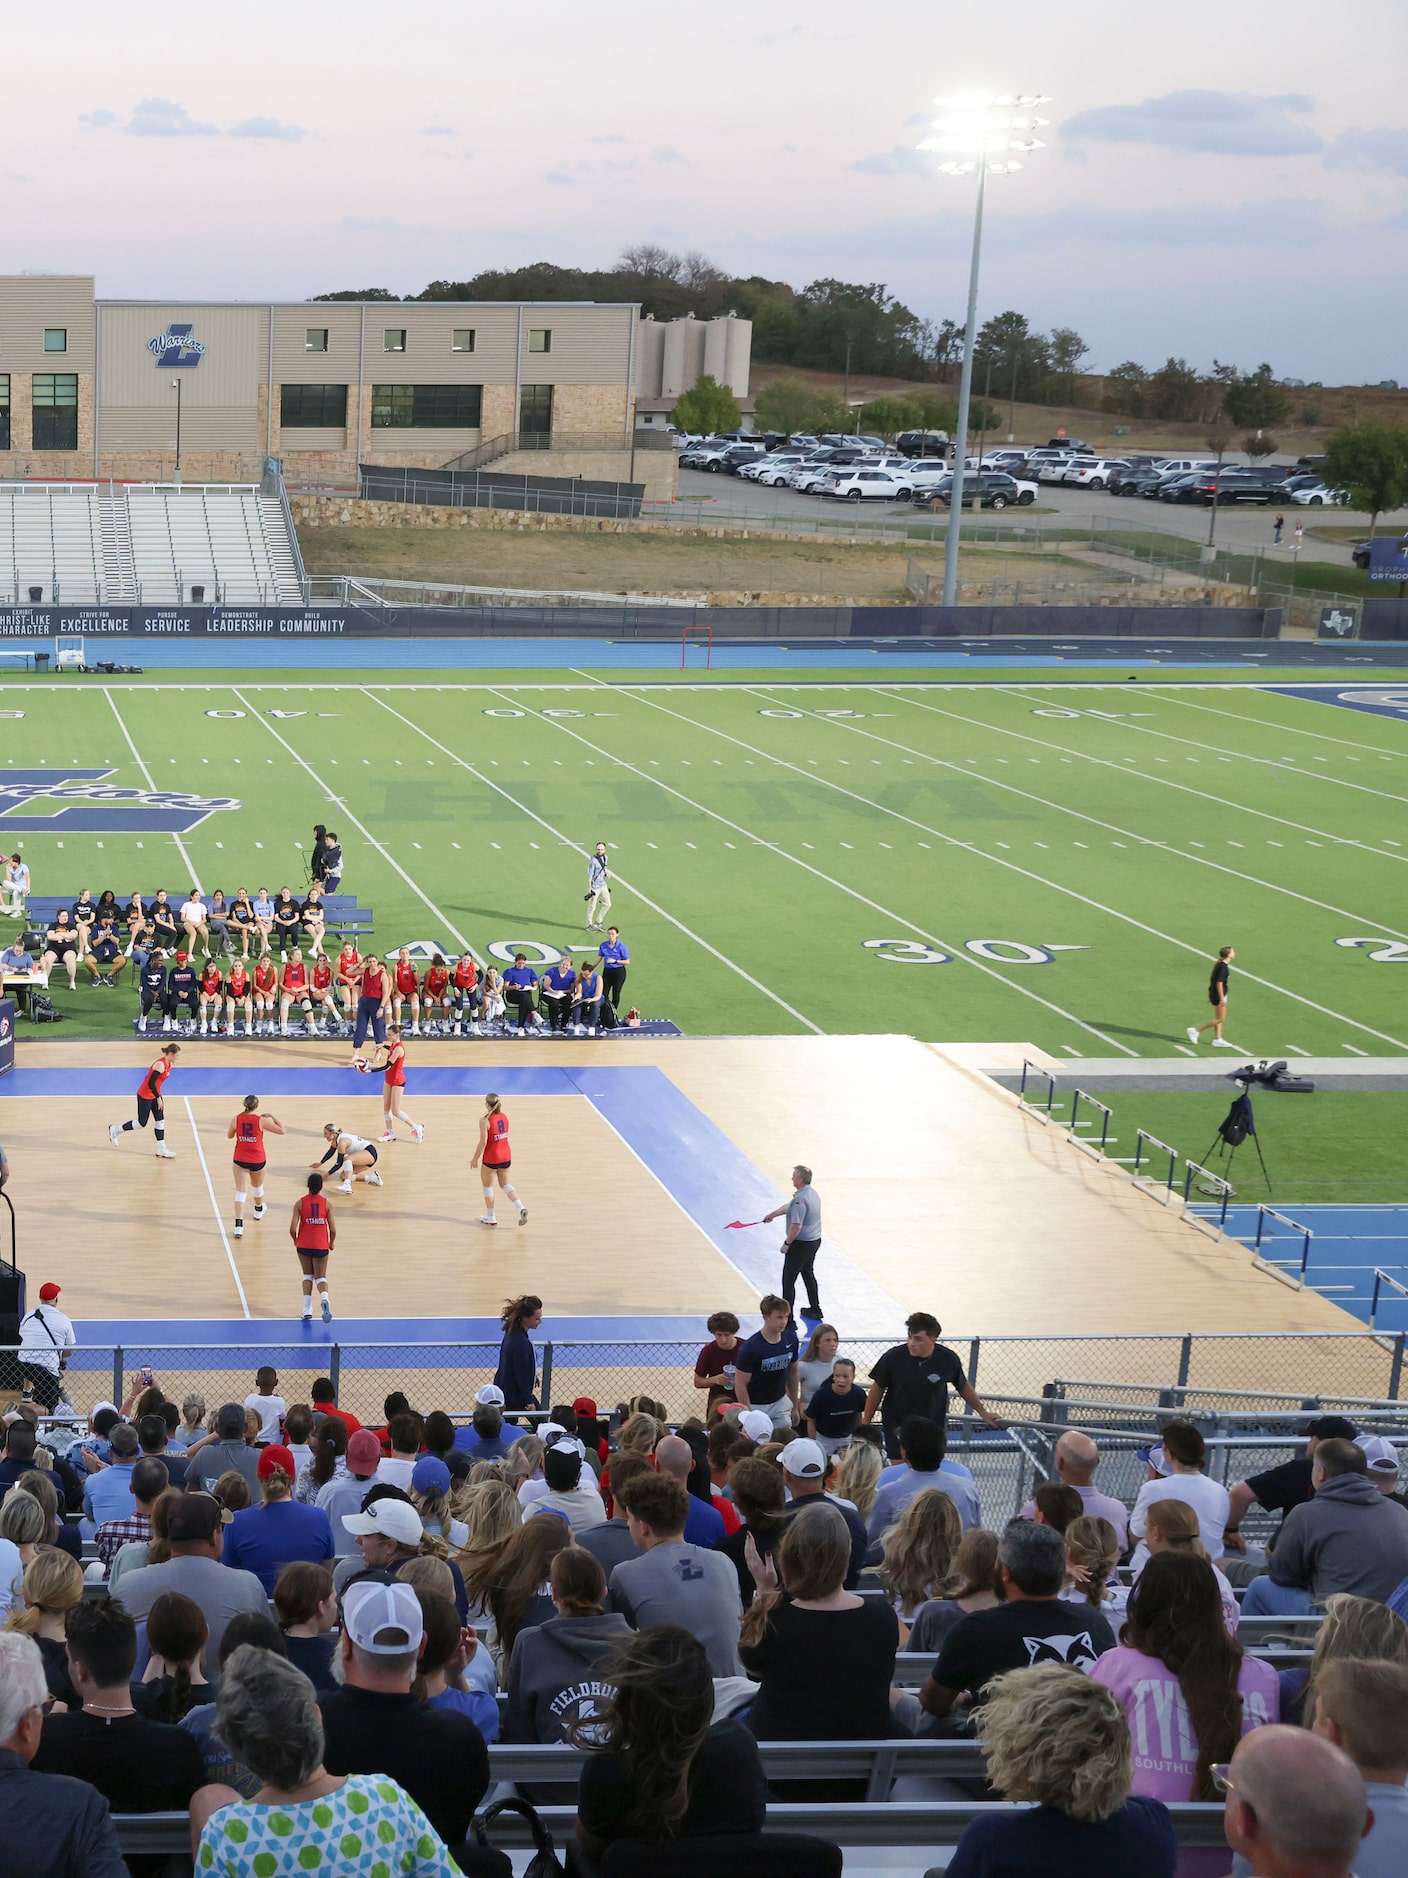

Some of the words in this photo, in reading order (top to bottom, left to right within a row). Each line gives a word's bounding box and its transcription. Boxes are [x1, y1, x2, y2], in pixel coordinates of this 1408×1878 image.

[147, 332, 206, 356] Warriors
[60, 619, 129, 632] EXCELLENCE
[144, 619, 191, 632] SERVICE
[206, 620, 274, 632] LEADERSHIP
[279, 620, 345, 632] COMMUNITY
[203, 709, 310, 720] 40
[481, 709, 588, 720] 30
[755, 709, 866, 720] 20
[1028, 709, 1126, 720] 10
[384, 940, 573, 966] 40
[861, 938, 1058, 966] 30
[1333, 936, 1408, 965] 2
[242, 1122, 254, 1137] 12
[496, 1119, 506, 1133] 8
[310, 1202, 320, 1218] 11
[1134, 1756, 1193, 1776] SOUTHL
